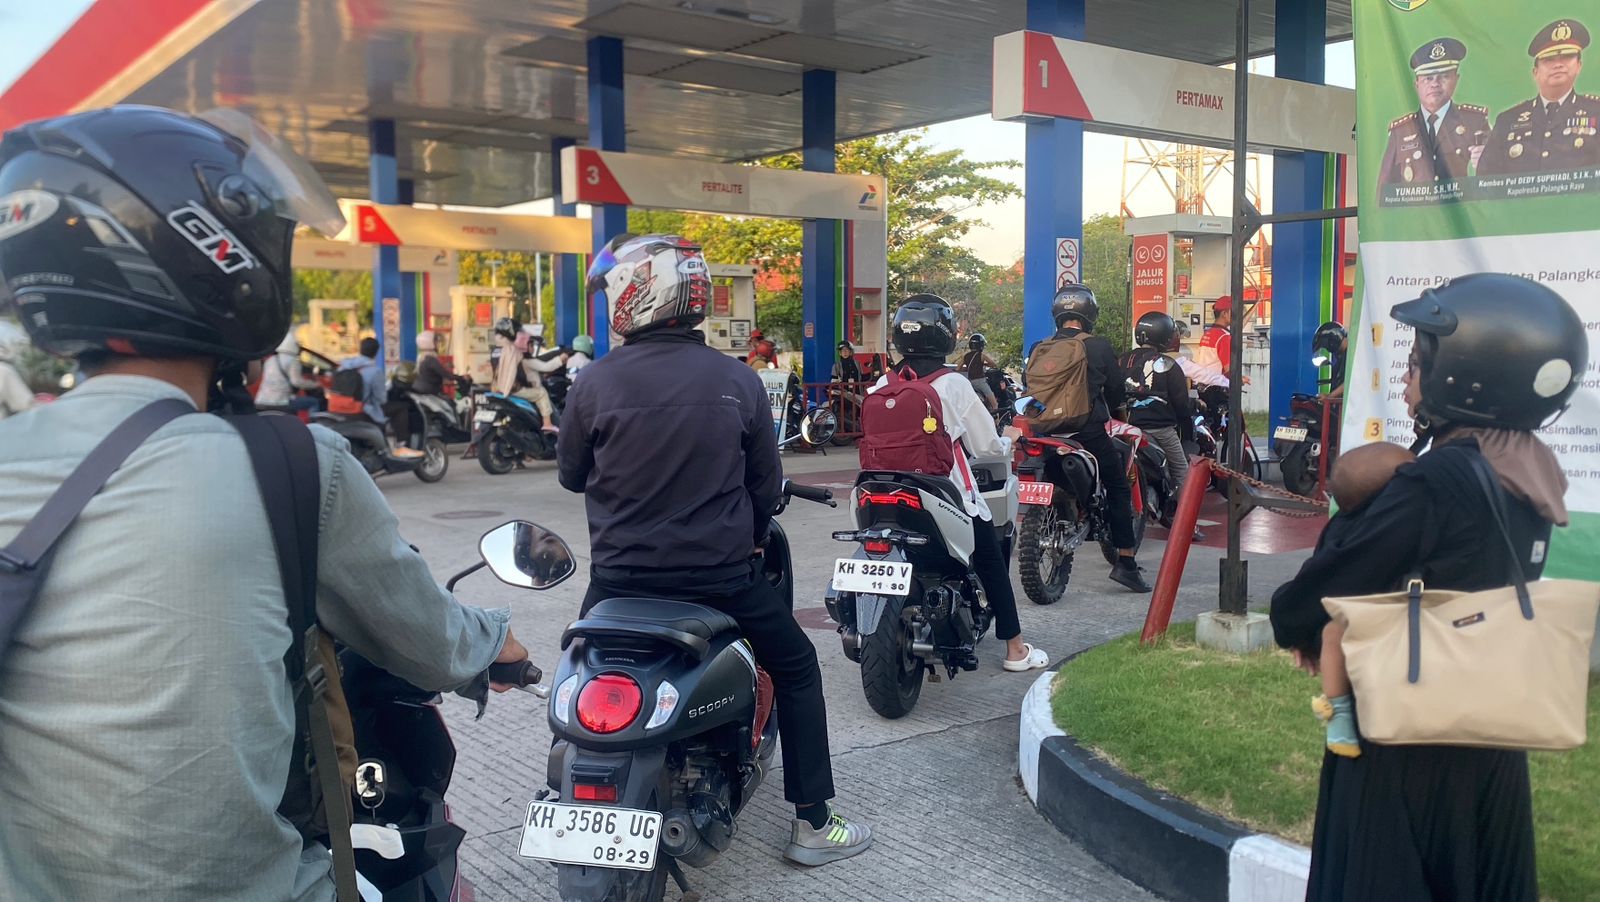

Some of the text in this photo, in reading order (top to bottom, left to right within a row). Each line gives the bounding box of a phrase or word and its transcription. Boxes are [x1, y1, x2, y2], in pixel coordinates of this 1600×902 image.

[1038, 59, 1049, 88] 1
[1176, 89, 1224, 111] PERTAMAX
[586, 165, 600, 185] 3
[701, 181, 743, 194] PERTALITE
[168, 207, 252, 273] GM
[1136, 268, 1163, 278] JALUR
[1136, 278, 1164, 286] KHUSUS
[1386, 275, 1430, 287] Antara
[1370, 422, 1380, 437] 3
[838, 562, 909, 578] KH 3250 V
[688, 694, 736, 720] SCOOPY
[529, 804, 656, 840] KH 3586 UG
